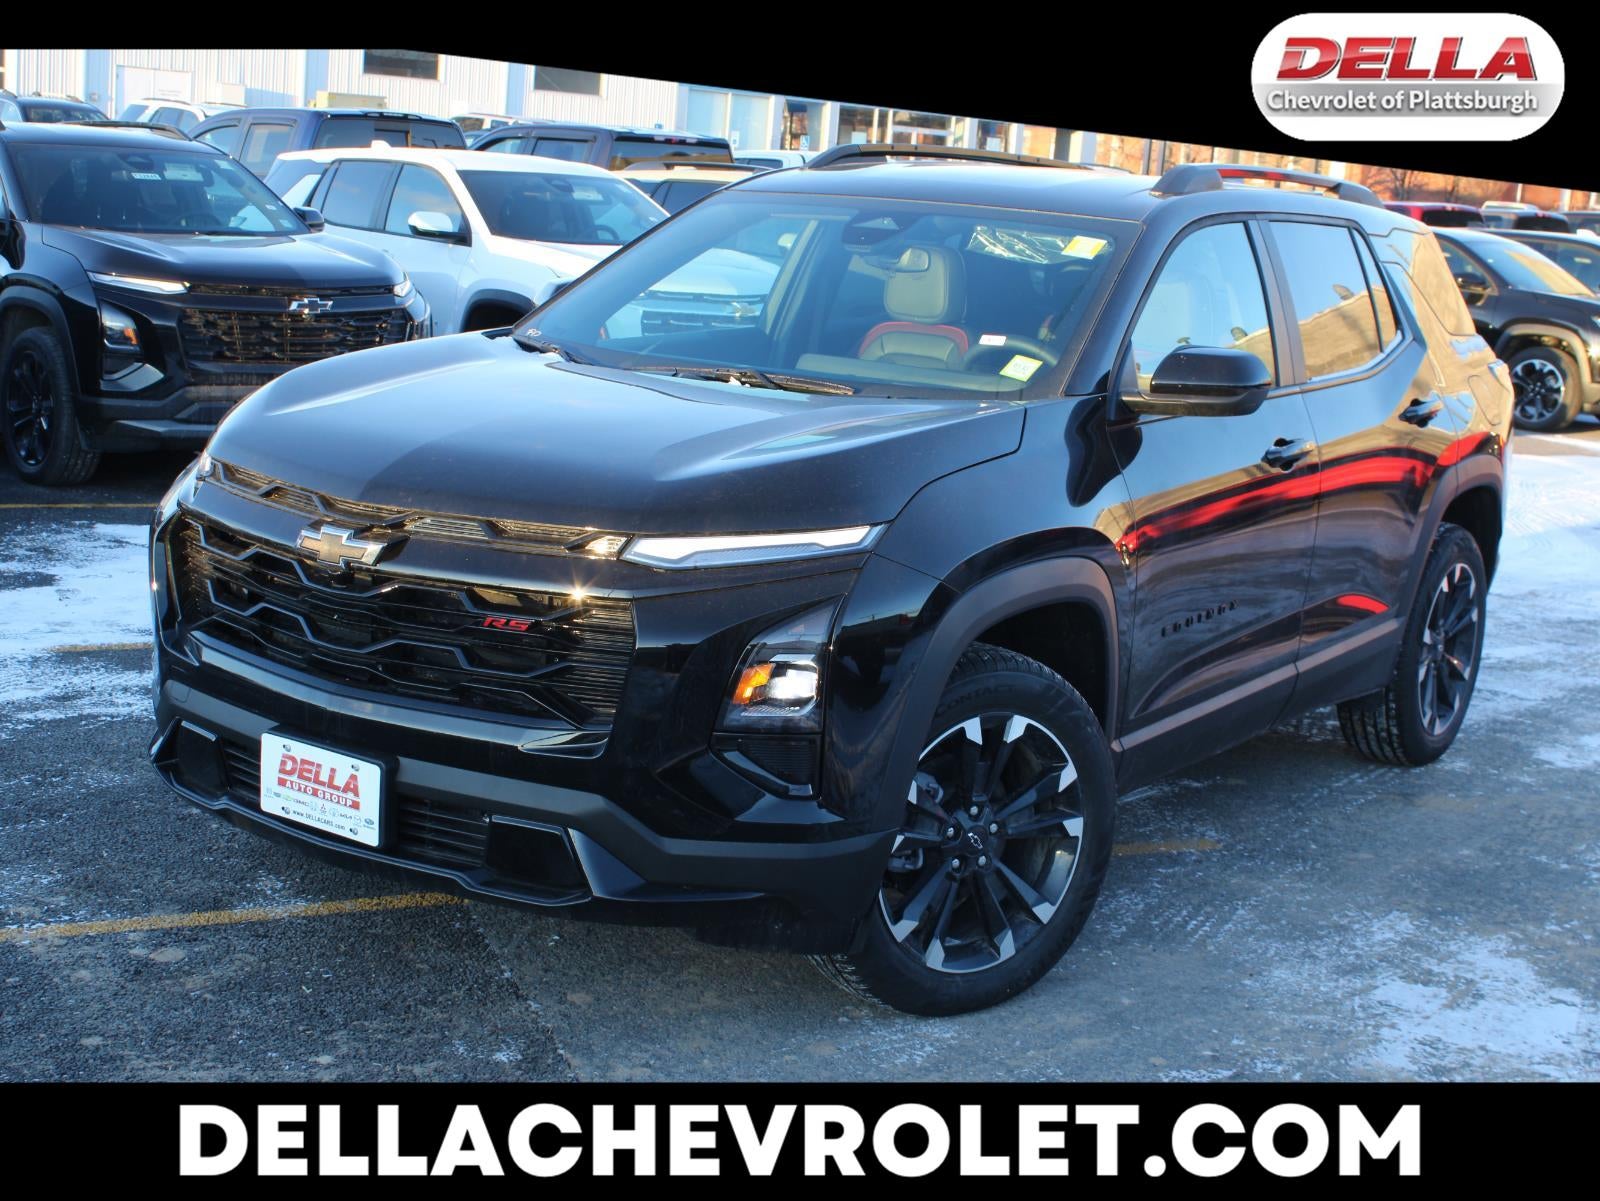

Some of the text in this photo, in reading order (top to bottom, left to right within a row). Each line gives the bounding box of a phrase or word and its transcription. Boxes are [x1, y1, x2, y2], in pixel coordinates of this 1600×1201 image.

[482, 616, 532, 631] RS
[278, 753, 360, 797] DELLA
[285, 780, 353, 808] AUTO GROUP
